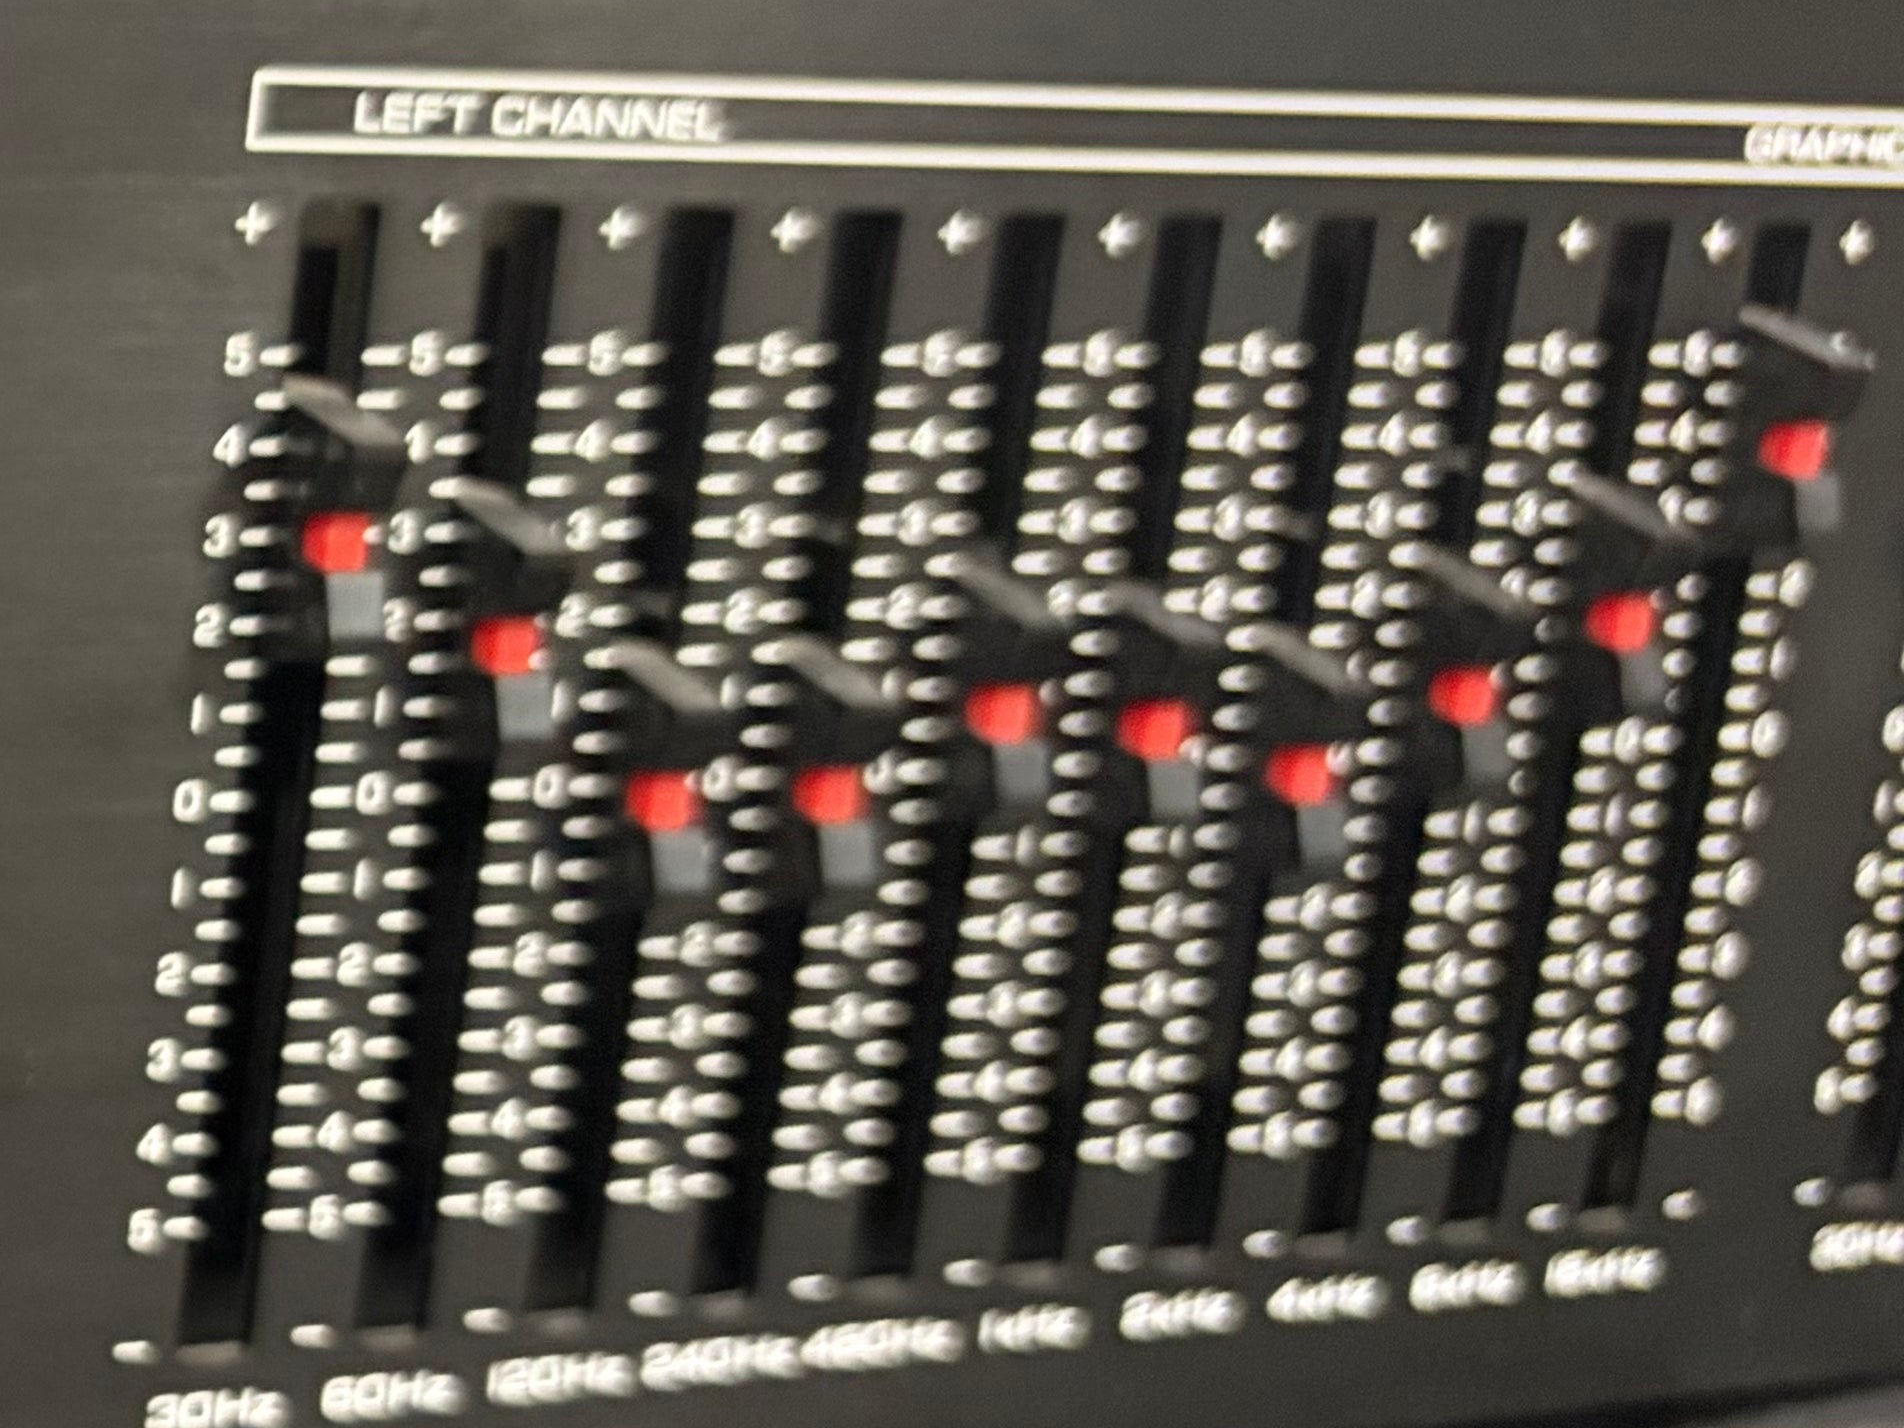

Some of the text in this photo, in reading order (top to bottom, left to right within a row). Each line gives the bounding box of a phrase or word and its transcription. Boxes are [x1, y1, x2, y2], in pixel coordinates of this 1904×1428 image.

[354, 91, 727, 143] LEFT CHANNEL
[224, 331, 256, 376] 5
[409, 330, 444, 376] 5
[213, 424, 247, 467] 4
[203, 513, 237, 558] 3
[388, 509, 422, 555] 3
[565, 506, 600, 551] 3
[194, 603, 229, 648] 2
[155, 952, 191, 996] 2
[337, 942, 375, 987] 2
[146, 1038, 182, 1082] 3
[327, 1027, 365, 1071] 3
[136, 1123, 173, 1166] 4
[317, 1110, 355, 1154] 4
[320, 1370, 462, 1423] 60Hz
